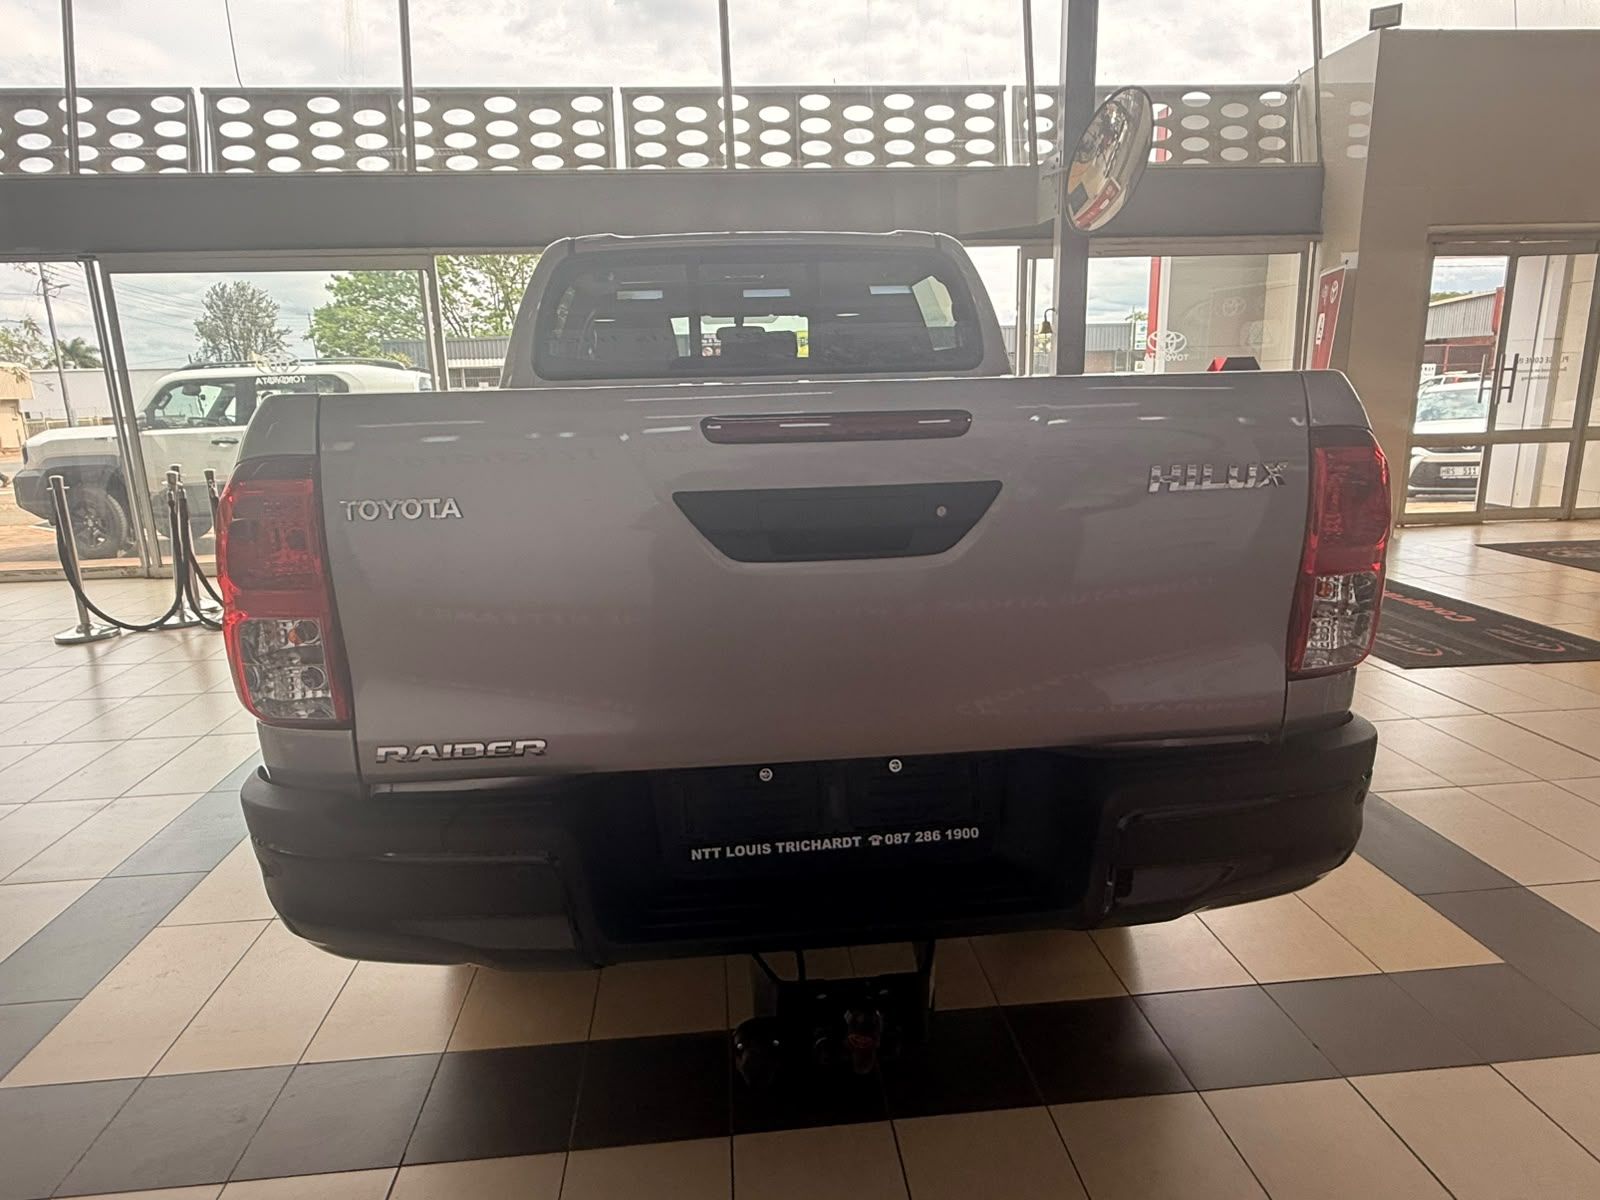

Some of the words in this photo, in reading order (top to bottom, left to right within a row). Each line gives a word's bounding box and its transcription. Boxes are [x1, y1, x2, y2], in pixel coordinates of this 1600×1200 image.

[1149, 461, 1288, 492] HILUX
[339, 498, 463, 521] TOYOTA
[376, 739, 548, 763] RAIDER
[691, 848, 721, 861] NTT
[726, 843, 771, 858] LOUIS
[775, 836, 862, 854] TRICHARDT
[885, 832, 910, 845] 087
[915, 830, 941, 843] 286
[945, 827, 979, 840] 1900
